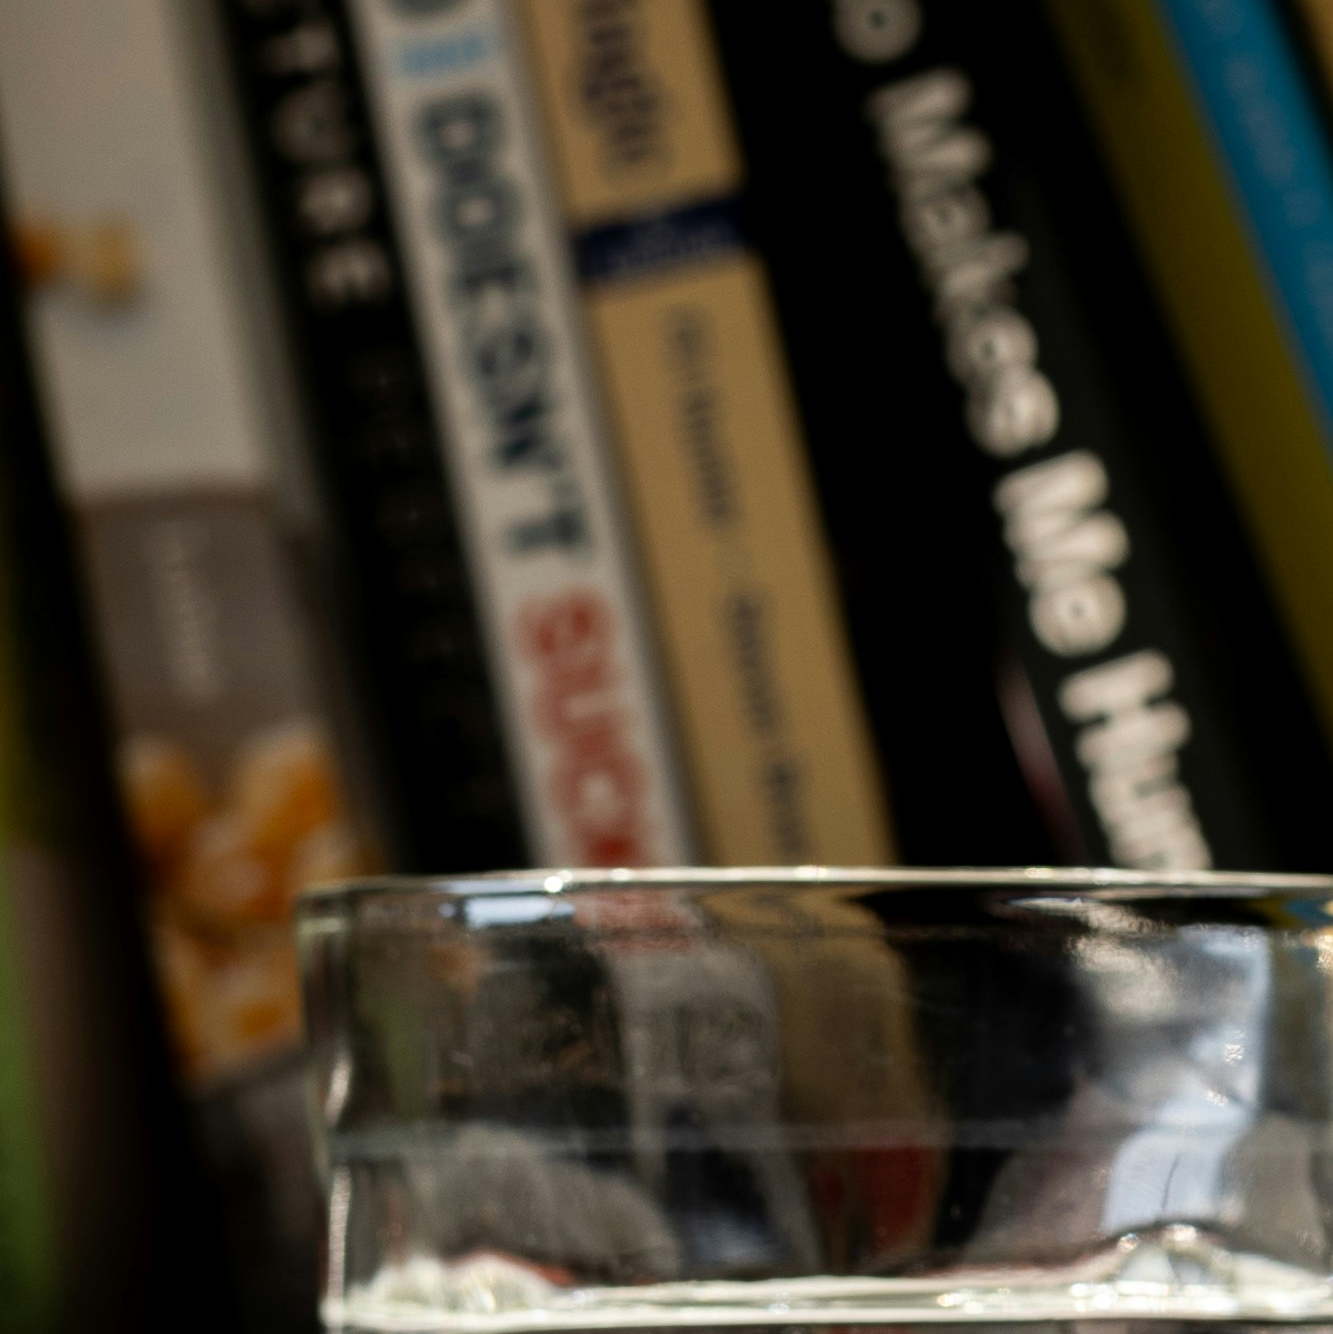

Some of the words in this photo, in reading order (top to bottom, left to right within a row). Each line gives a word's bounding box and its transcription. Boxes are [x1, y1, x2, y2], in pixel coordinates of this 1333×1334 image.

[415, 89, 590, 559] DOESN'T
[860, 62, 1062, 461] Makes
[990, 447, 1132, 659] Me
